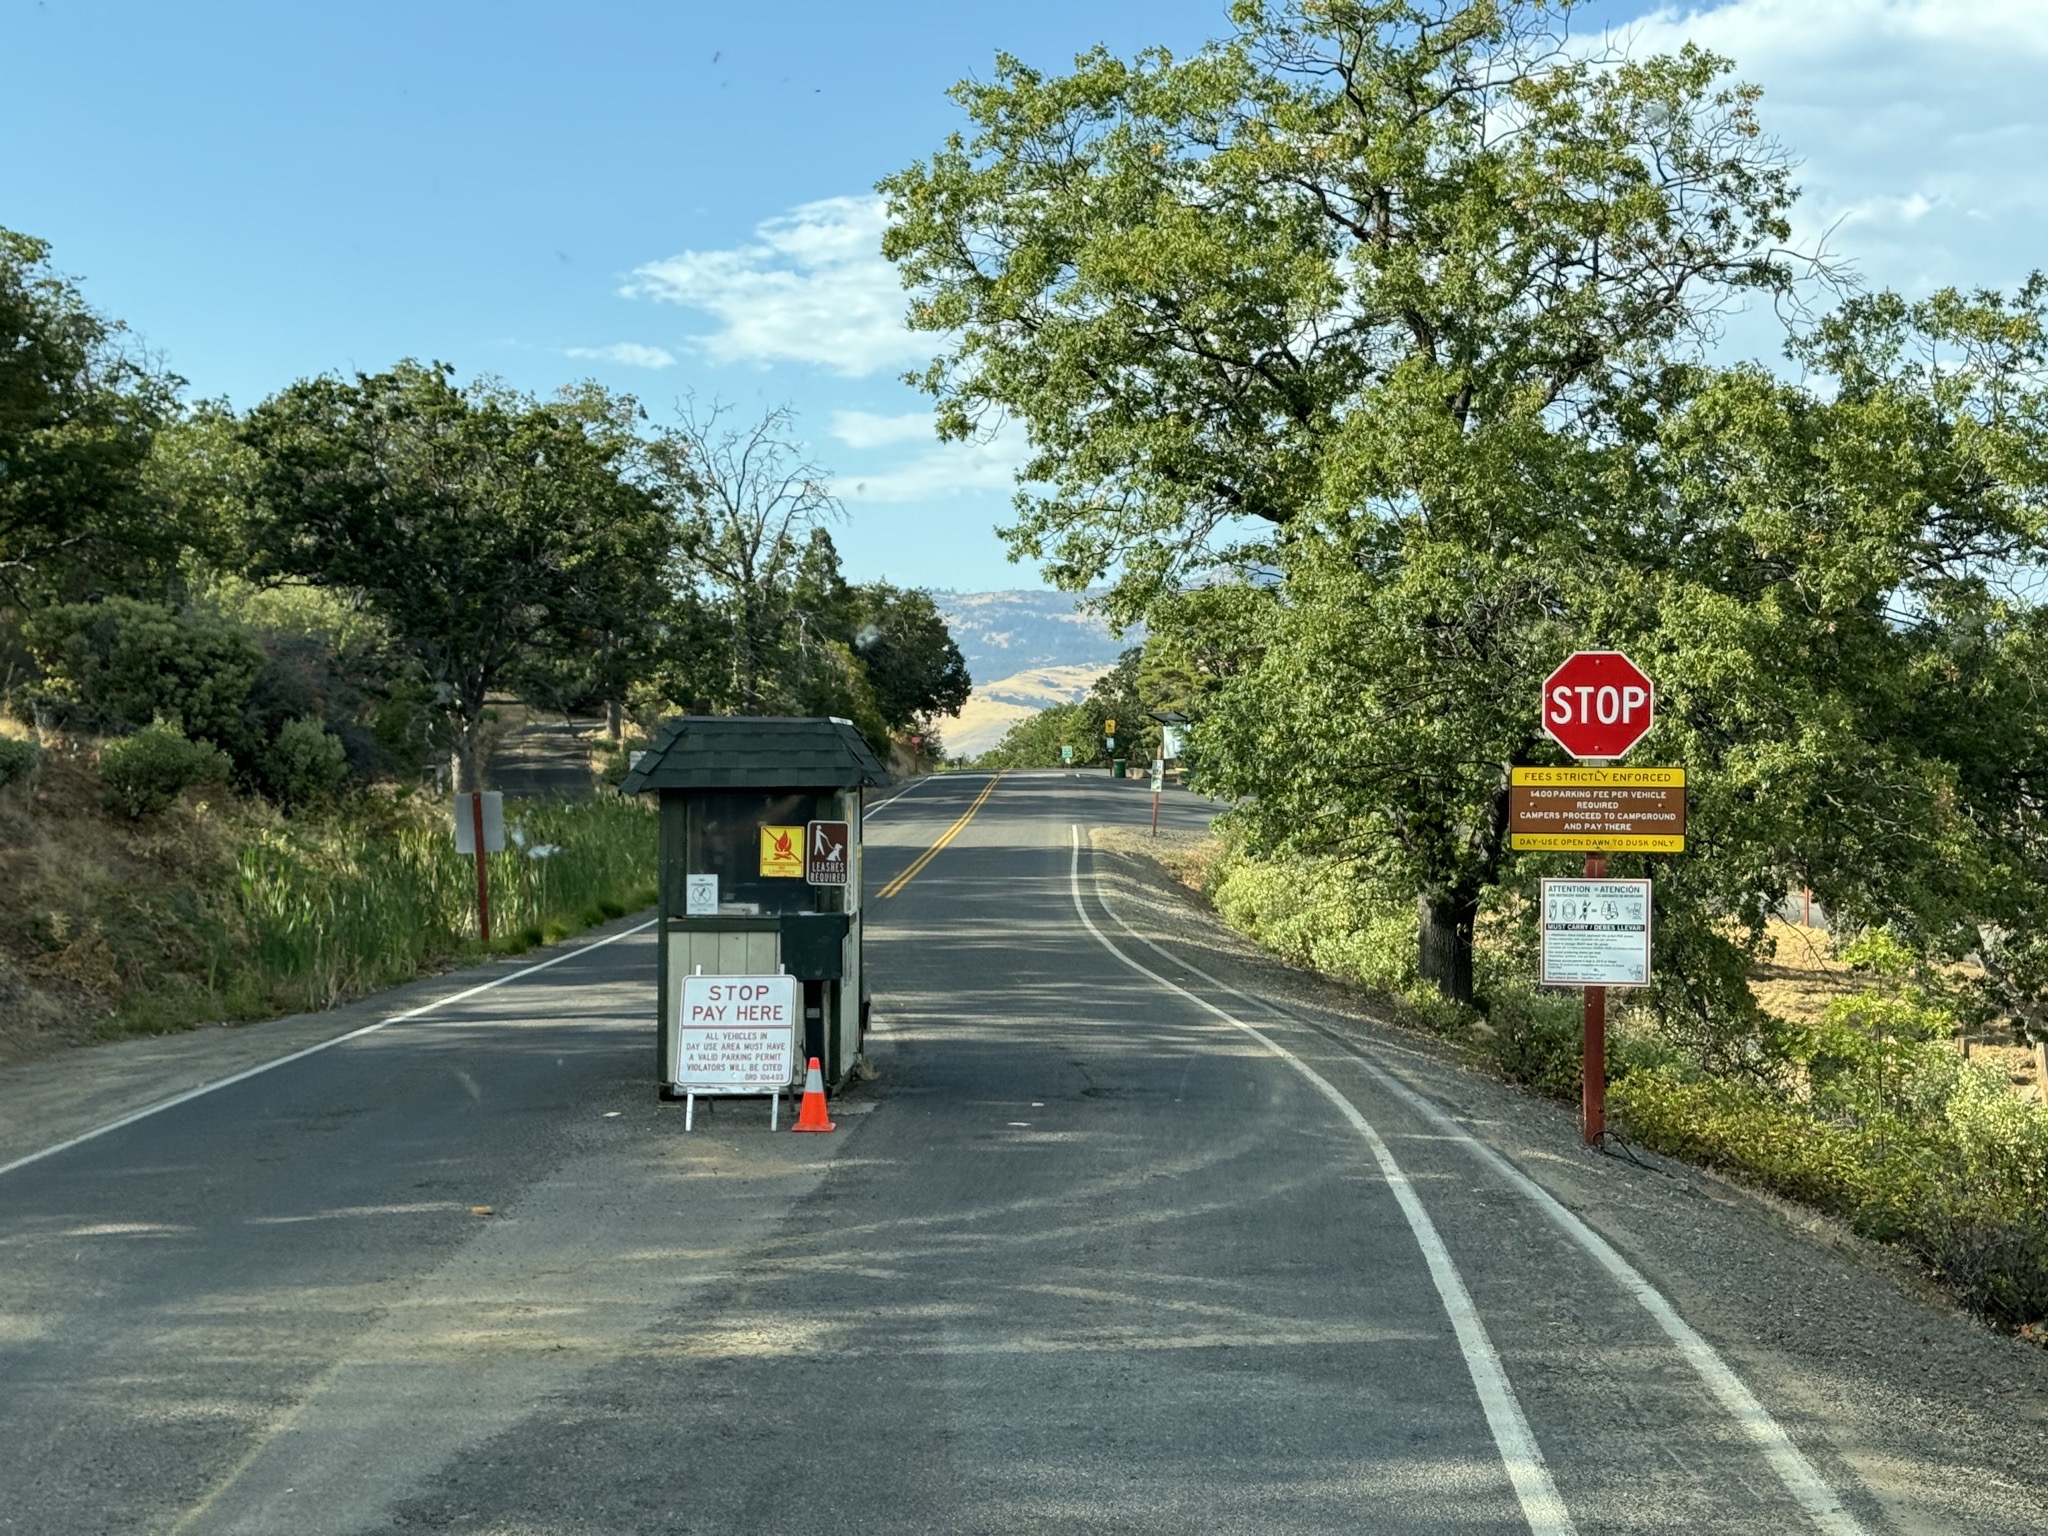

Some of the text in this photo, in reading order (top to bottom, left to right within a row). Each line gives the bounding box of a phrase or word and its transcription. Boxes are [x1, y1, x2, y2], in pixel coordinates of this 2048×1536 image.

[1550, 685, 1645, 725] STOP
[1524, 772, 1671, 782] FEES STRICTLY ENFORCED
[1553, 790, 1591, 798] PARKING
[1593, 791, 1609, 799] FEE
[1611, 791, 1629, 799] PER
[1631, 791, 1667, 799] VEHICLE
[1576, 801, 1619, 810] REQUIRED
[1520, 811, 1676, 821] CAMPERS PROCEED TO CAMPGROUND
[1564, 823, 1632, 831] AND PAY THERE
[1519, 838, 1558, 846] DAY-USE
[1586, 839, 1610, 847] DAWN
[1613, 839, 1624, 847] TO
[1626, 839, 1649, 847] DUSK
[1652, 839, 1675, 847] ONLY
[811, 861, 844, 872] LEASHES
[810, 872, 846, 882] REQUIRED
[1548, 885, 1640, 893] ATTENTION ATENCIÓN
[708, 985, 769, 1001] STOP
[692, 1005, 783, 1021] PAY HERE
[705, 1032, 768, 1040] ALL VEHICLES IN
[686, 1043, 785, 1051] DAY USE AREA MUST HAVE
[688, 1053, 782, 1061] A VALID PARKING PERMIT
[687, 1063, 783, 1071] VIOLATORS WILL BE CITED
